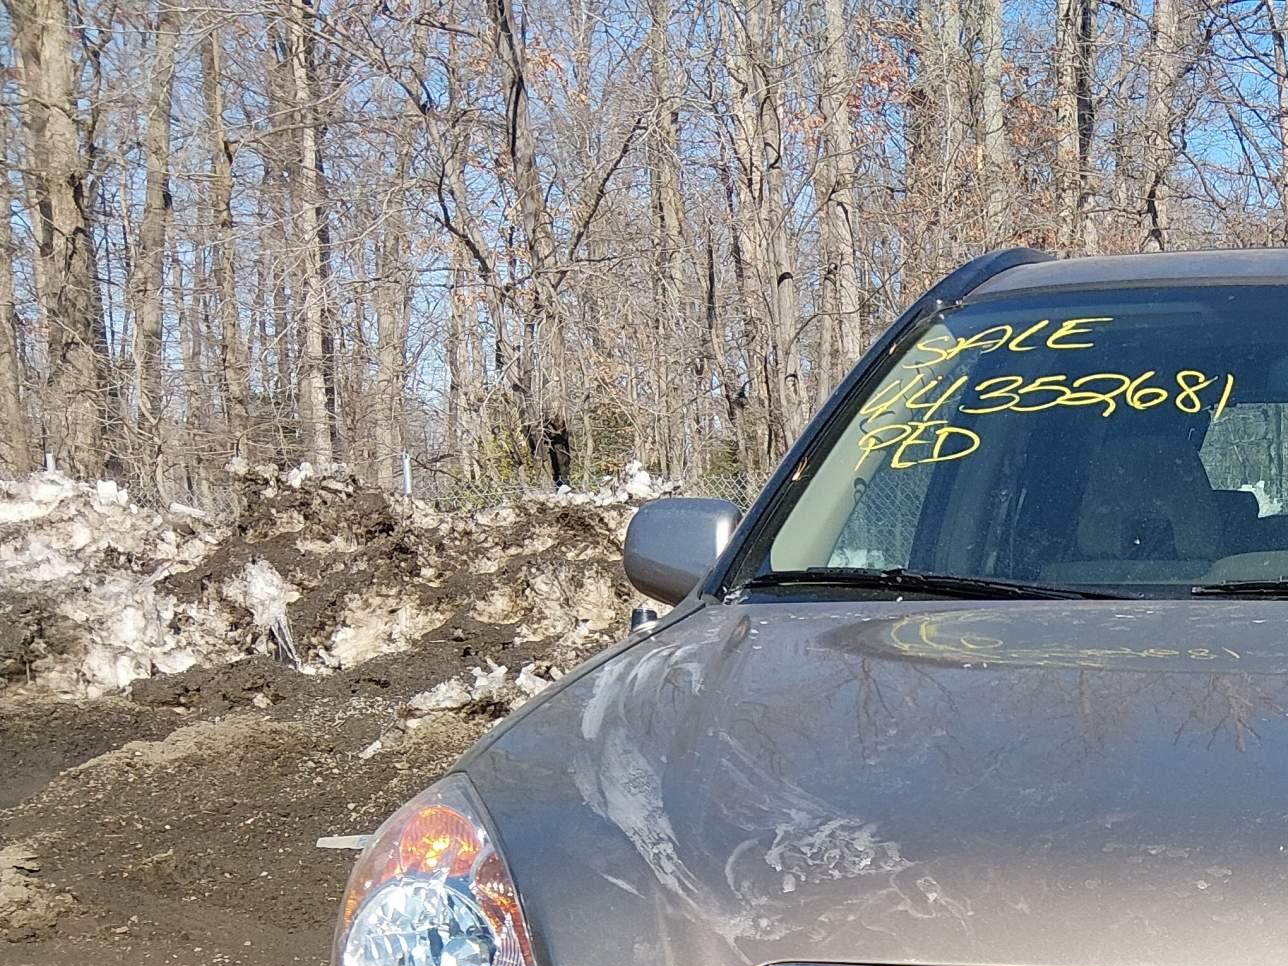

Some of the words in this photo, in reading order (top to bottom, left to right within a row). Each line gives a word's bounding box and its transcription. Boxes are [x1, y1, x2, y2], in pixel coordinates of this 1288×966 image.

[903, 317, 1114, 369] SALE
[861, 370, 1235, 423] 44352681
[855, 420, 981, 471] PED
